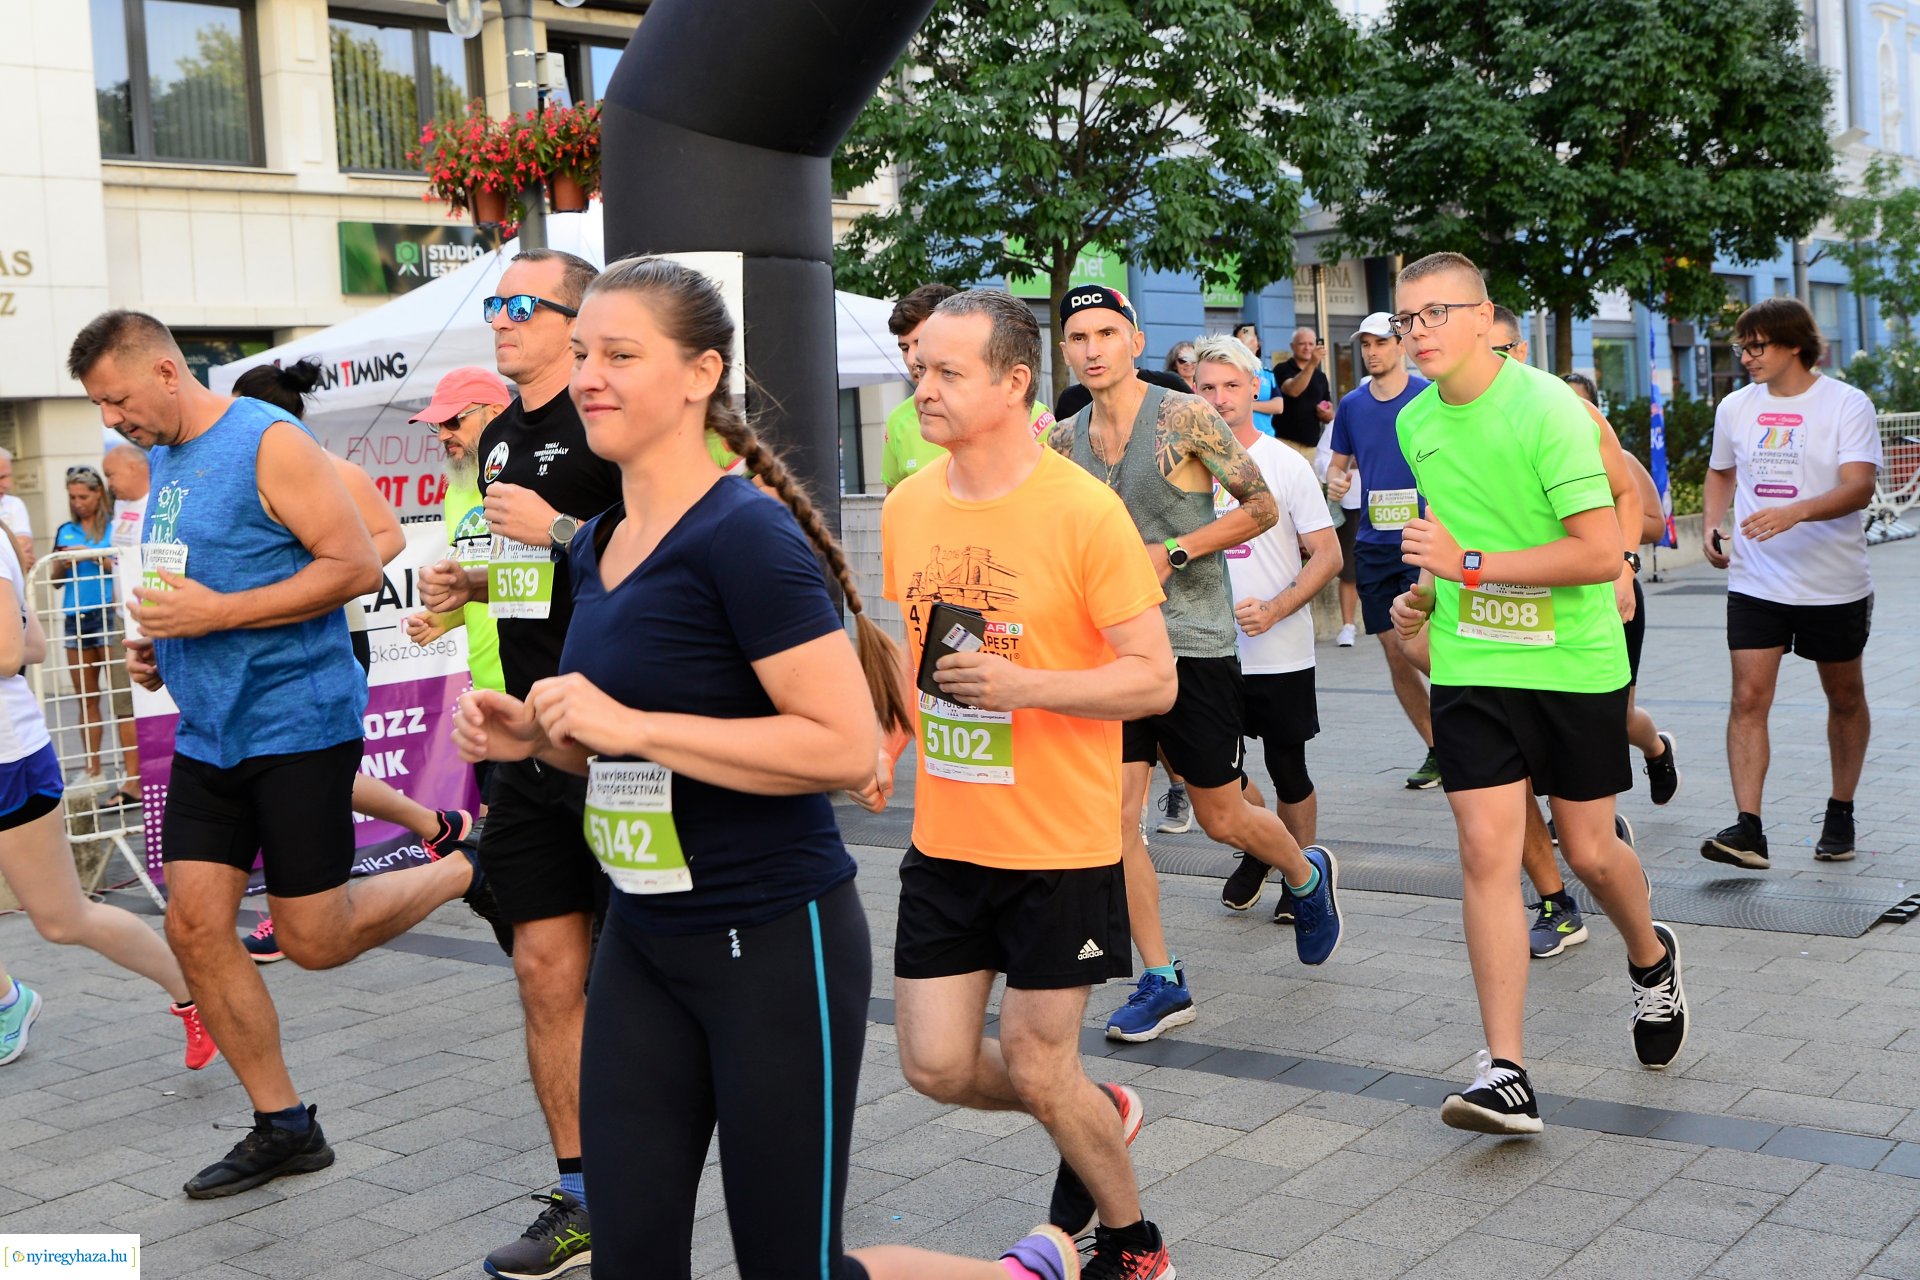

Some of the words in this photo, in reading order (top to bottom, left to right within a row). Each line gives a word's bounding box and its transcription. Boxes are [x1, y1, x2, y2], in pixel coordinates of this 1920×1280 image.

[311, 367, 339, 392] AN
[340, 352, 408, 387] TIMING
[1374, 506, 1410, 522] 5069
[497, 567, 539, 598] 5139
[1471, 596, 1539, 628] 5098
[985, 624, 1006, 633] AR
[363, 707, 427, 742] OZZ
[927, 721, 993, 760] 5102
[359, 749, 409, 780] NK
[590, 814, 658, 863] 5142
[1077, 950, 1104, 960] adidas
